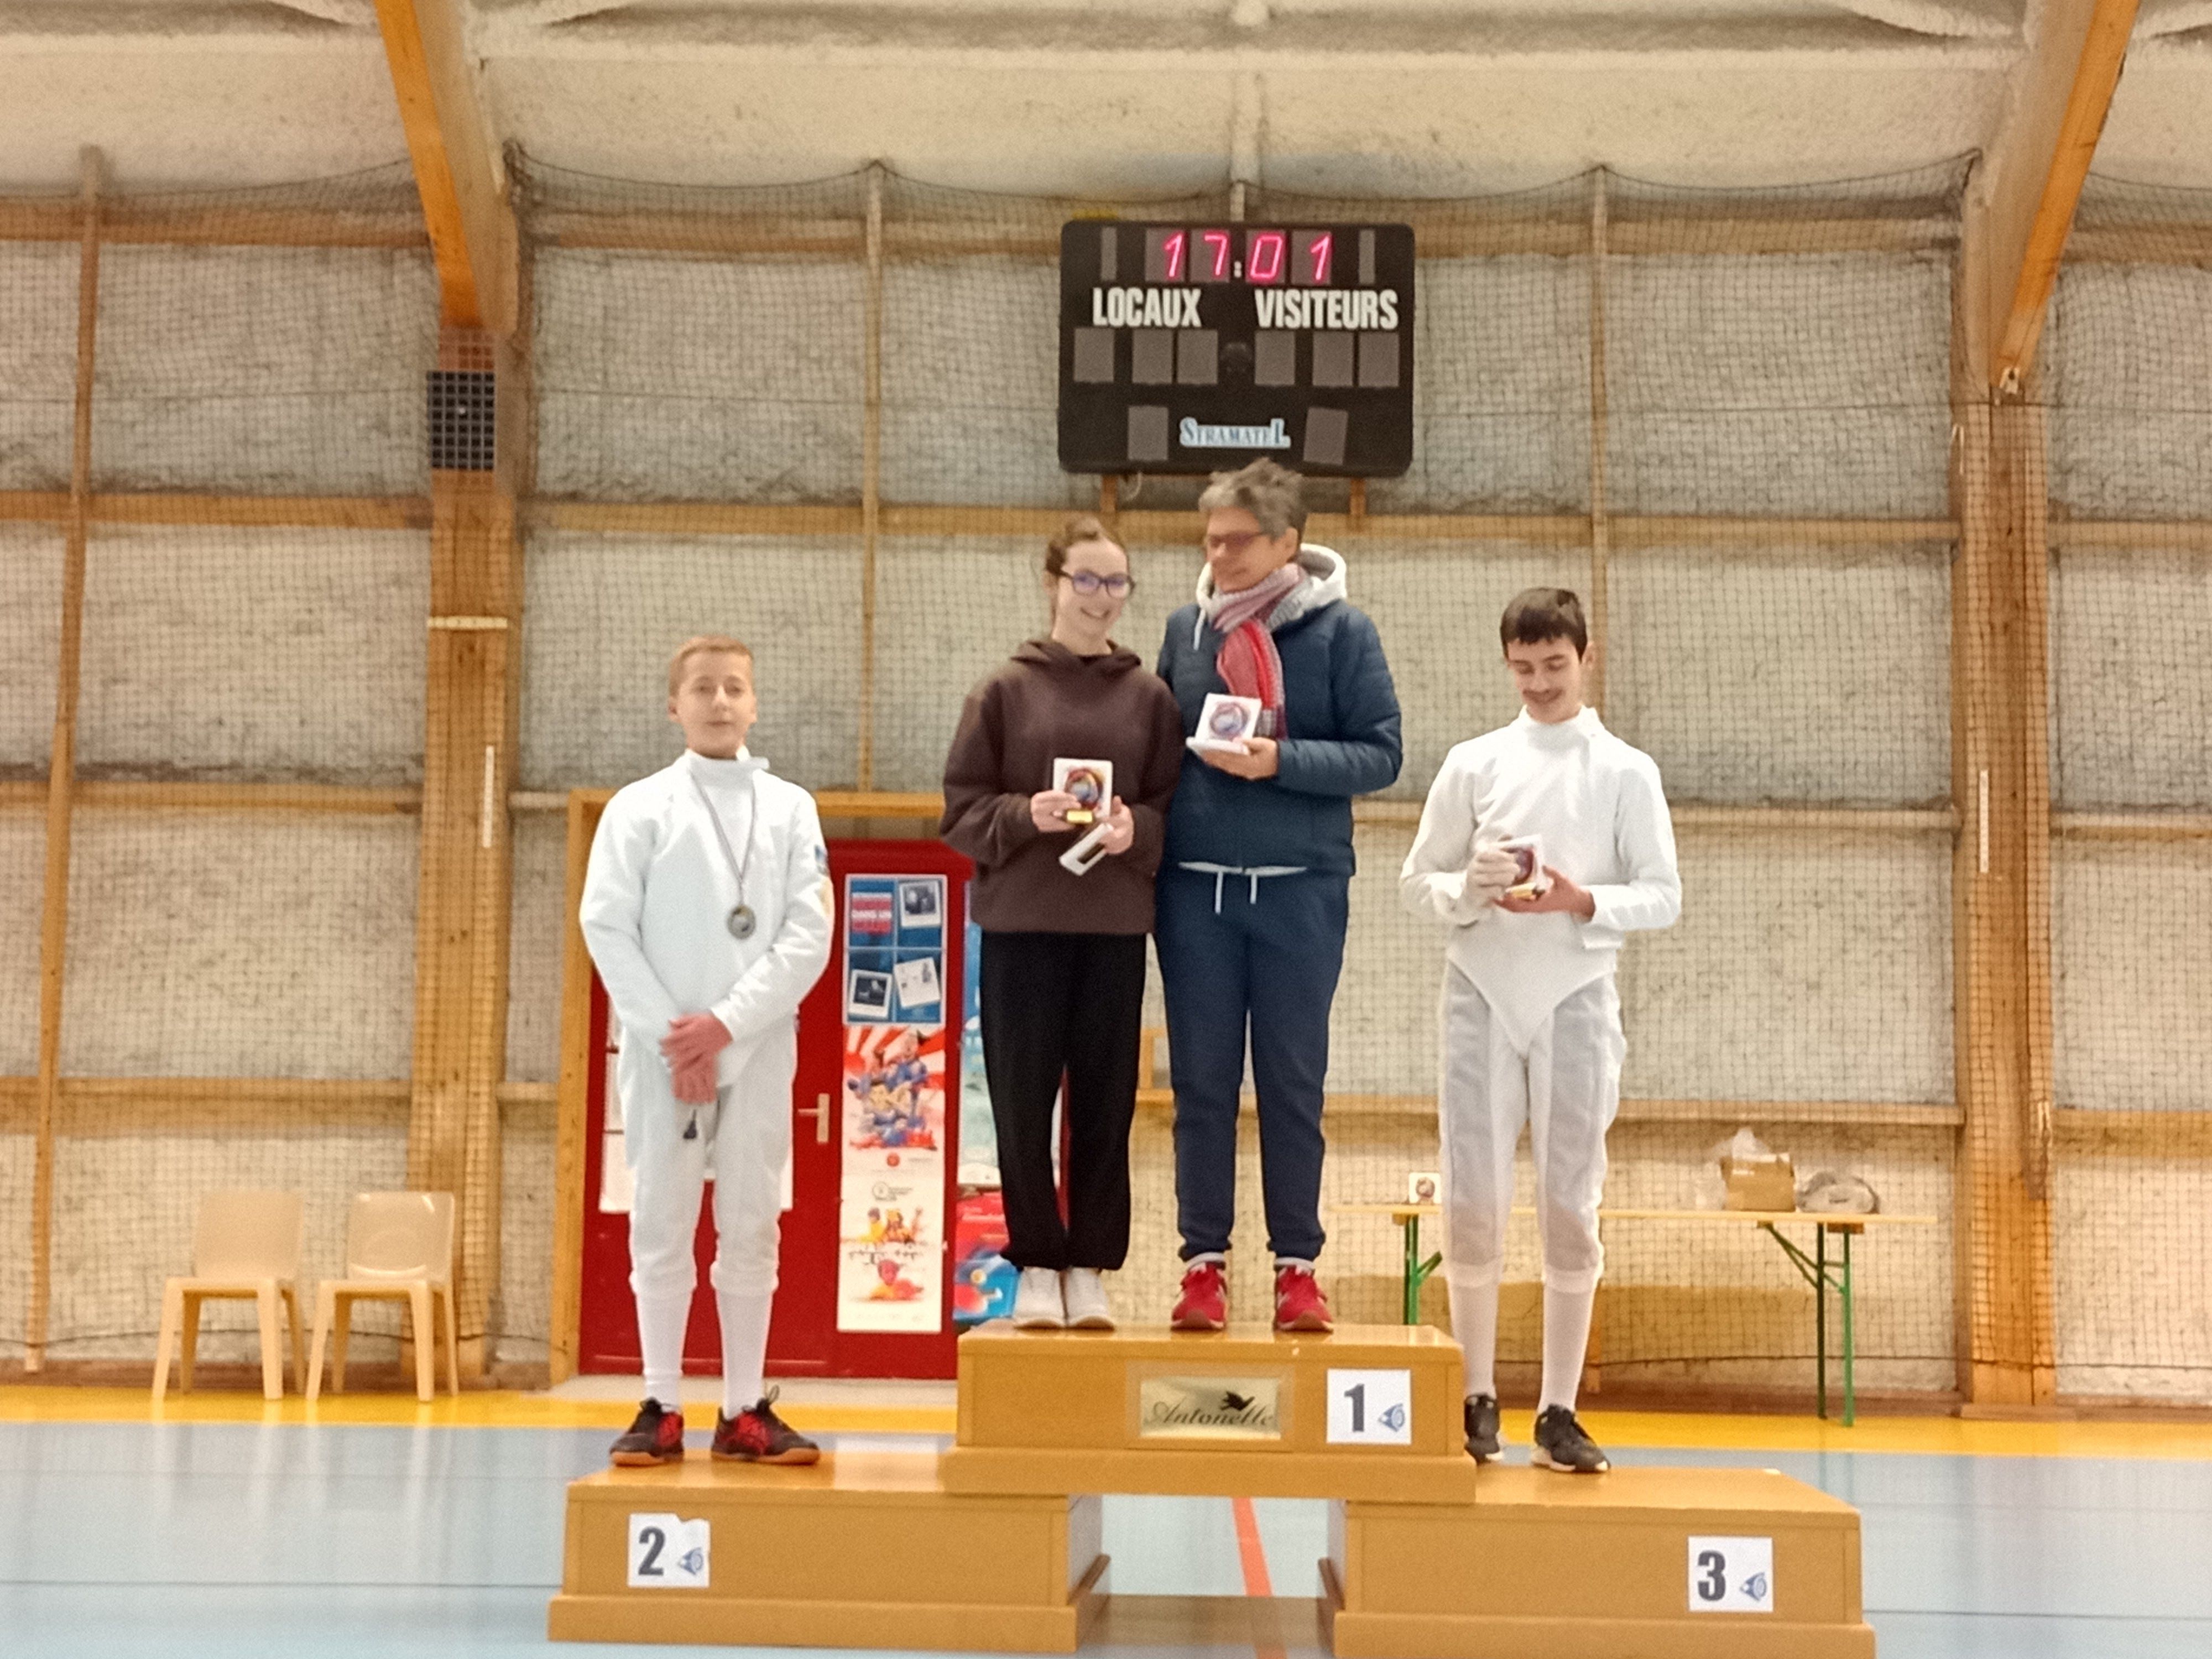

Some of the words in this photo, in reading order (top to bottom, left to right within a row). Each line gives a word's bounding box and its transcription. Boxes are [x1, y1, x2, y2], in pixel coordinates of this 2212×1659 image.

[1165, 233, 1332, 281] 17:01
[1092, 287, 1202, 328] LOCAUX
[1254, 289, 1399, 330] VISITEURS
[1147, 1395, 1274, 1426] Antonelle
[1344, 1383, 1364, 1432] 1
[638, 1526, 665, 1576] 2
[1697, 1550, 1726, 1601] 3
